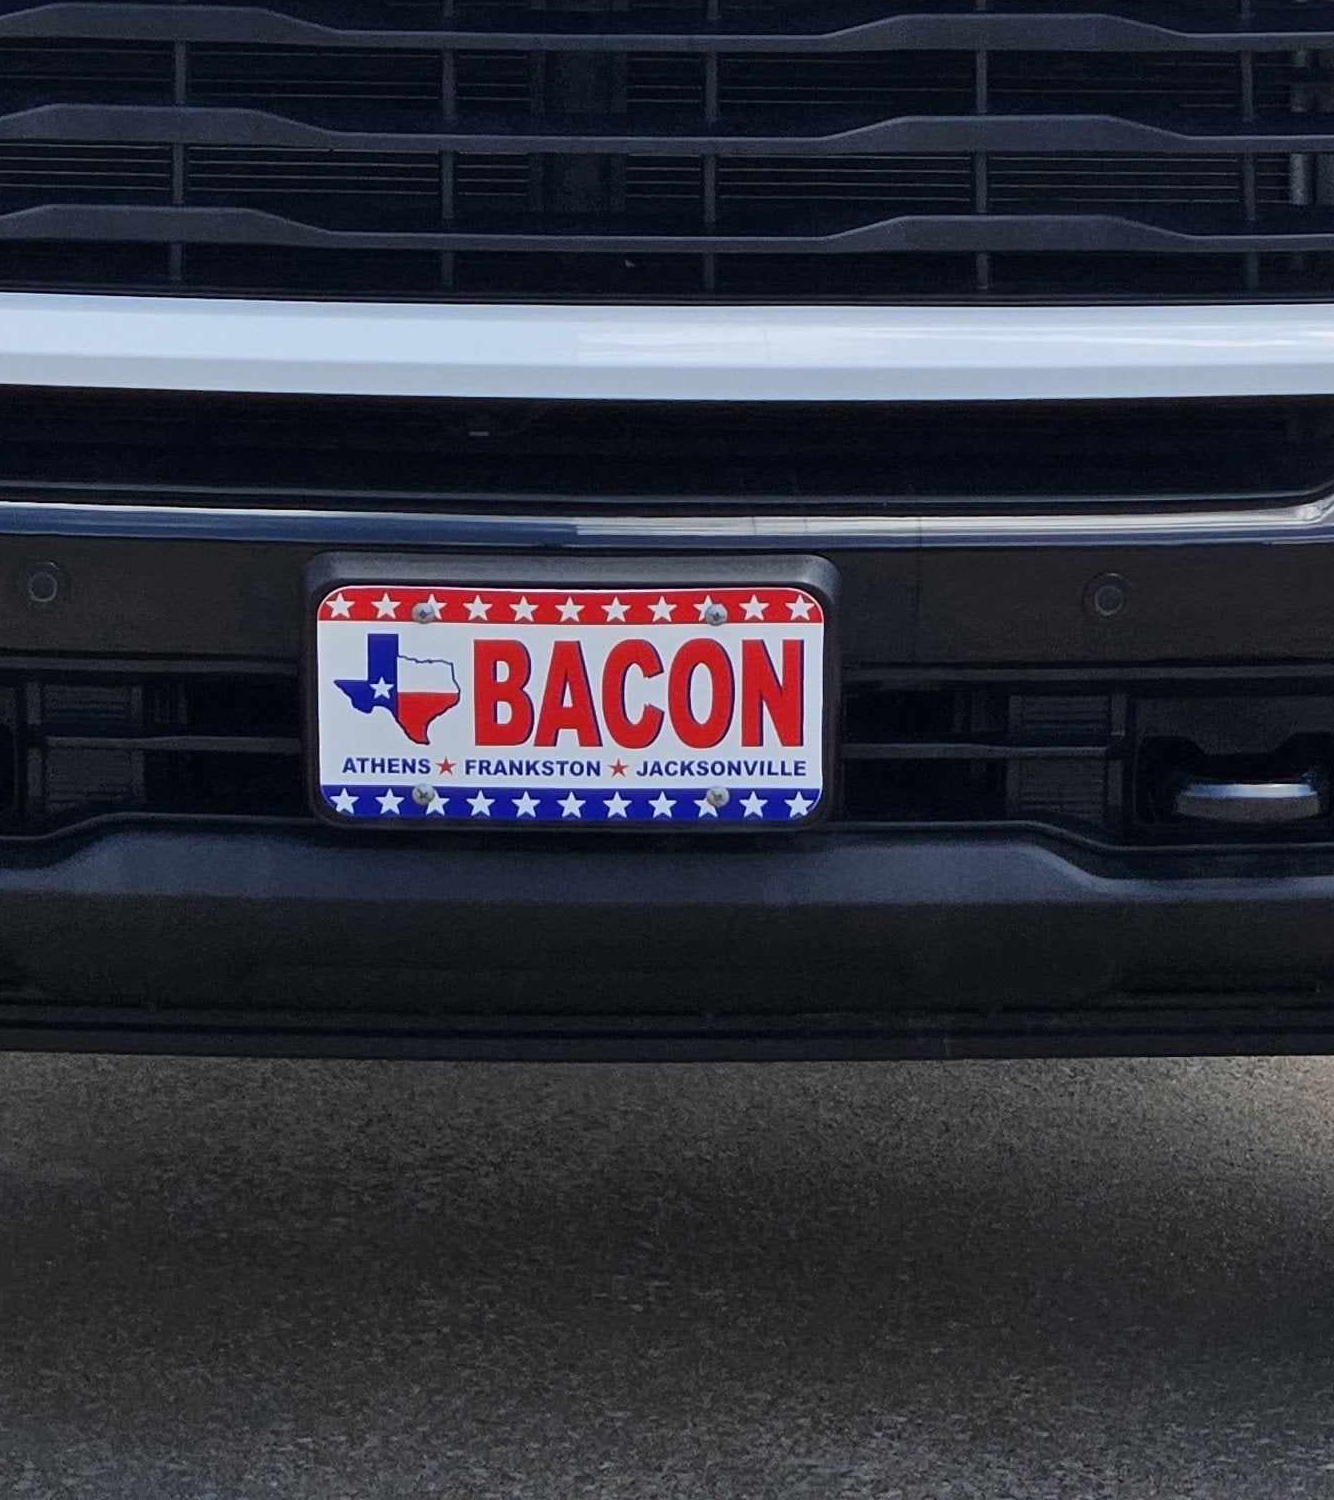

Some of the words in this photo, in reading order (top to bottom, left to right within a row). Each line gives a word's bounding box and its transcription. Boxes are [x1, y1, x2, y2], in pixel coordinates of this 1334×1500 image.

[473, 638, 805, 748] BACON
[342, 757, 431, 775] ATHENS
[465, 758, 601, 777] FRANKSTON
[636, 760, 807, 777] JACKSONVILLE
